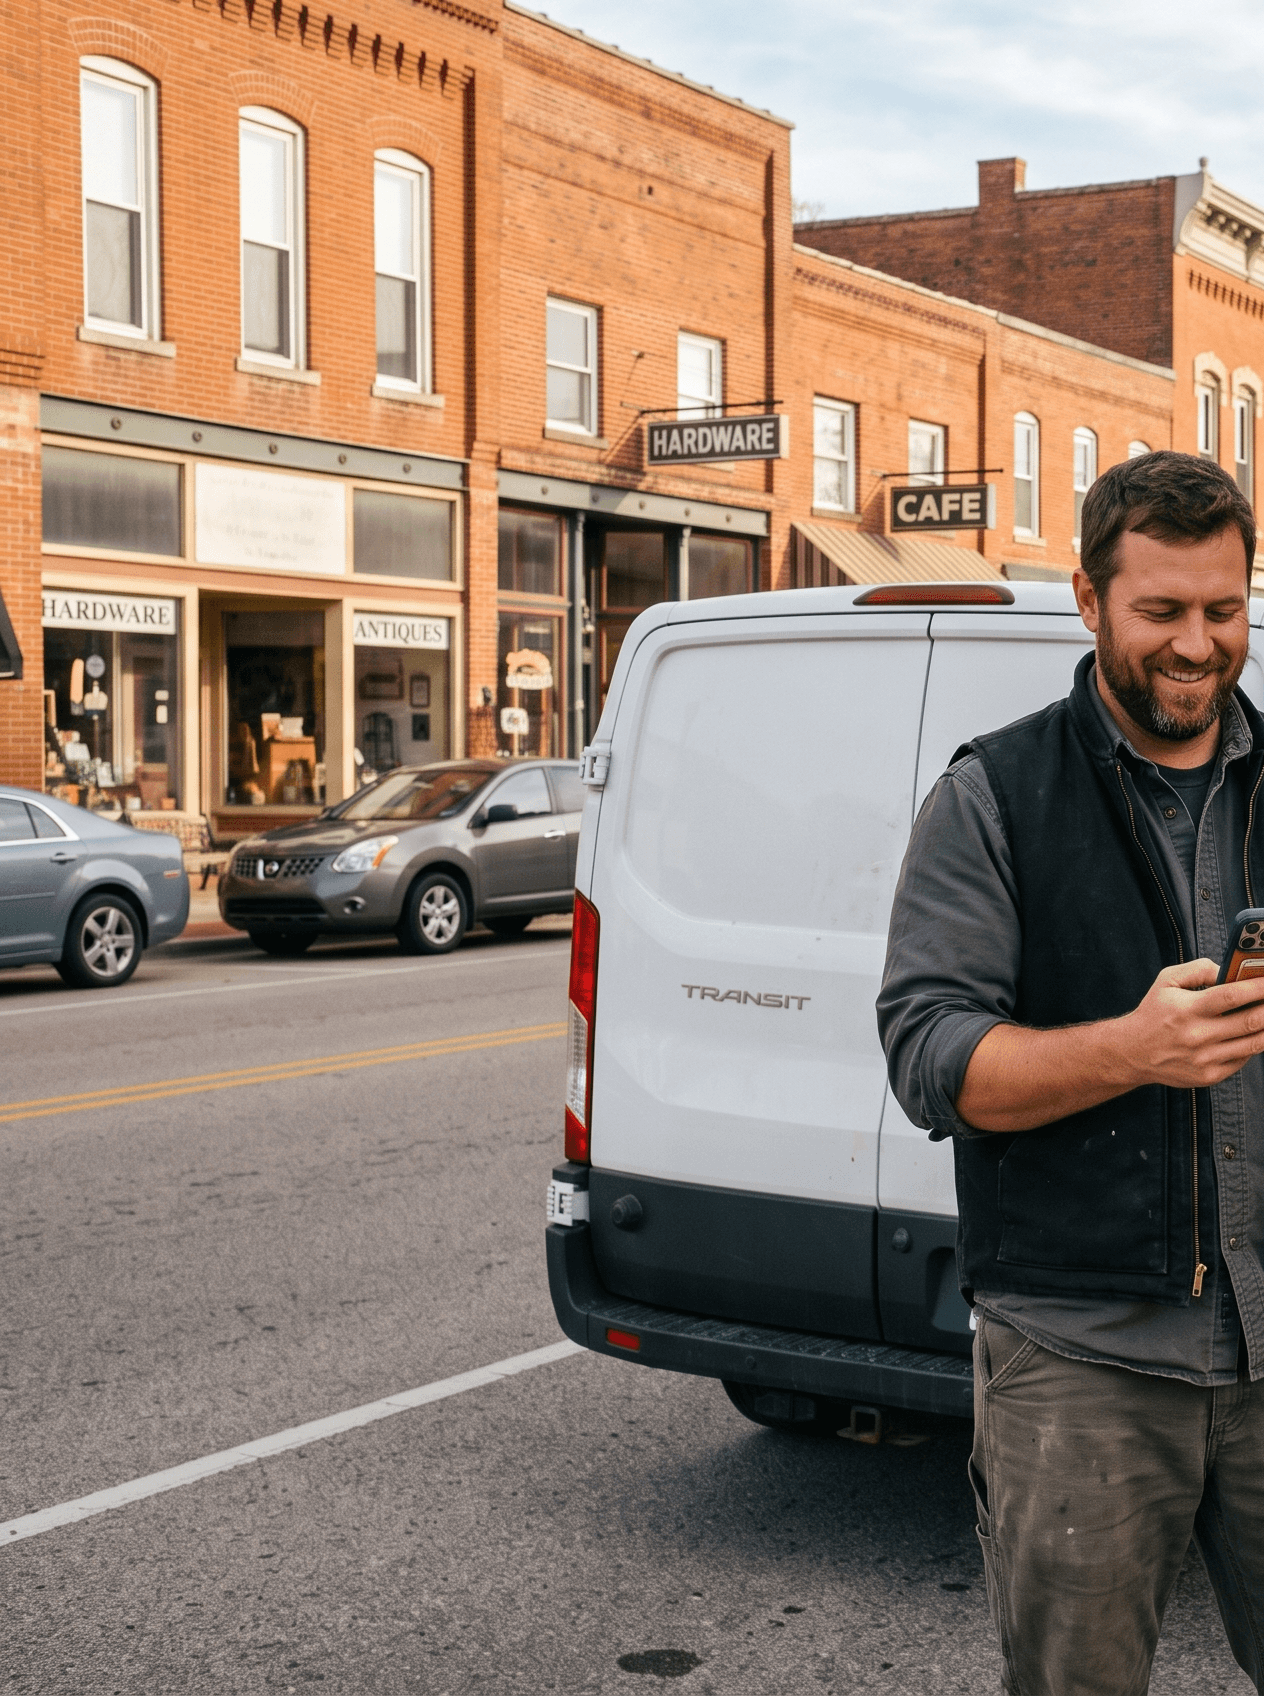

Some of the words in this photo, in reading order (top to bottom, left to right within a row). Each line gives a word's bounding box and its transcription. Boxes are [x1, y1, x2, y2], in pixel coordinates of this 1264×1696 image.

[653, 422, 775, 456] HARDWARE
[897, 492, 981, 522] CAFE
[42, 598, 170, 625] HARDWARE
[355, 620, 442, 643] ANTIQUES
[681, 984, 811, 1010] TRANSIT
